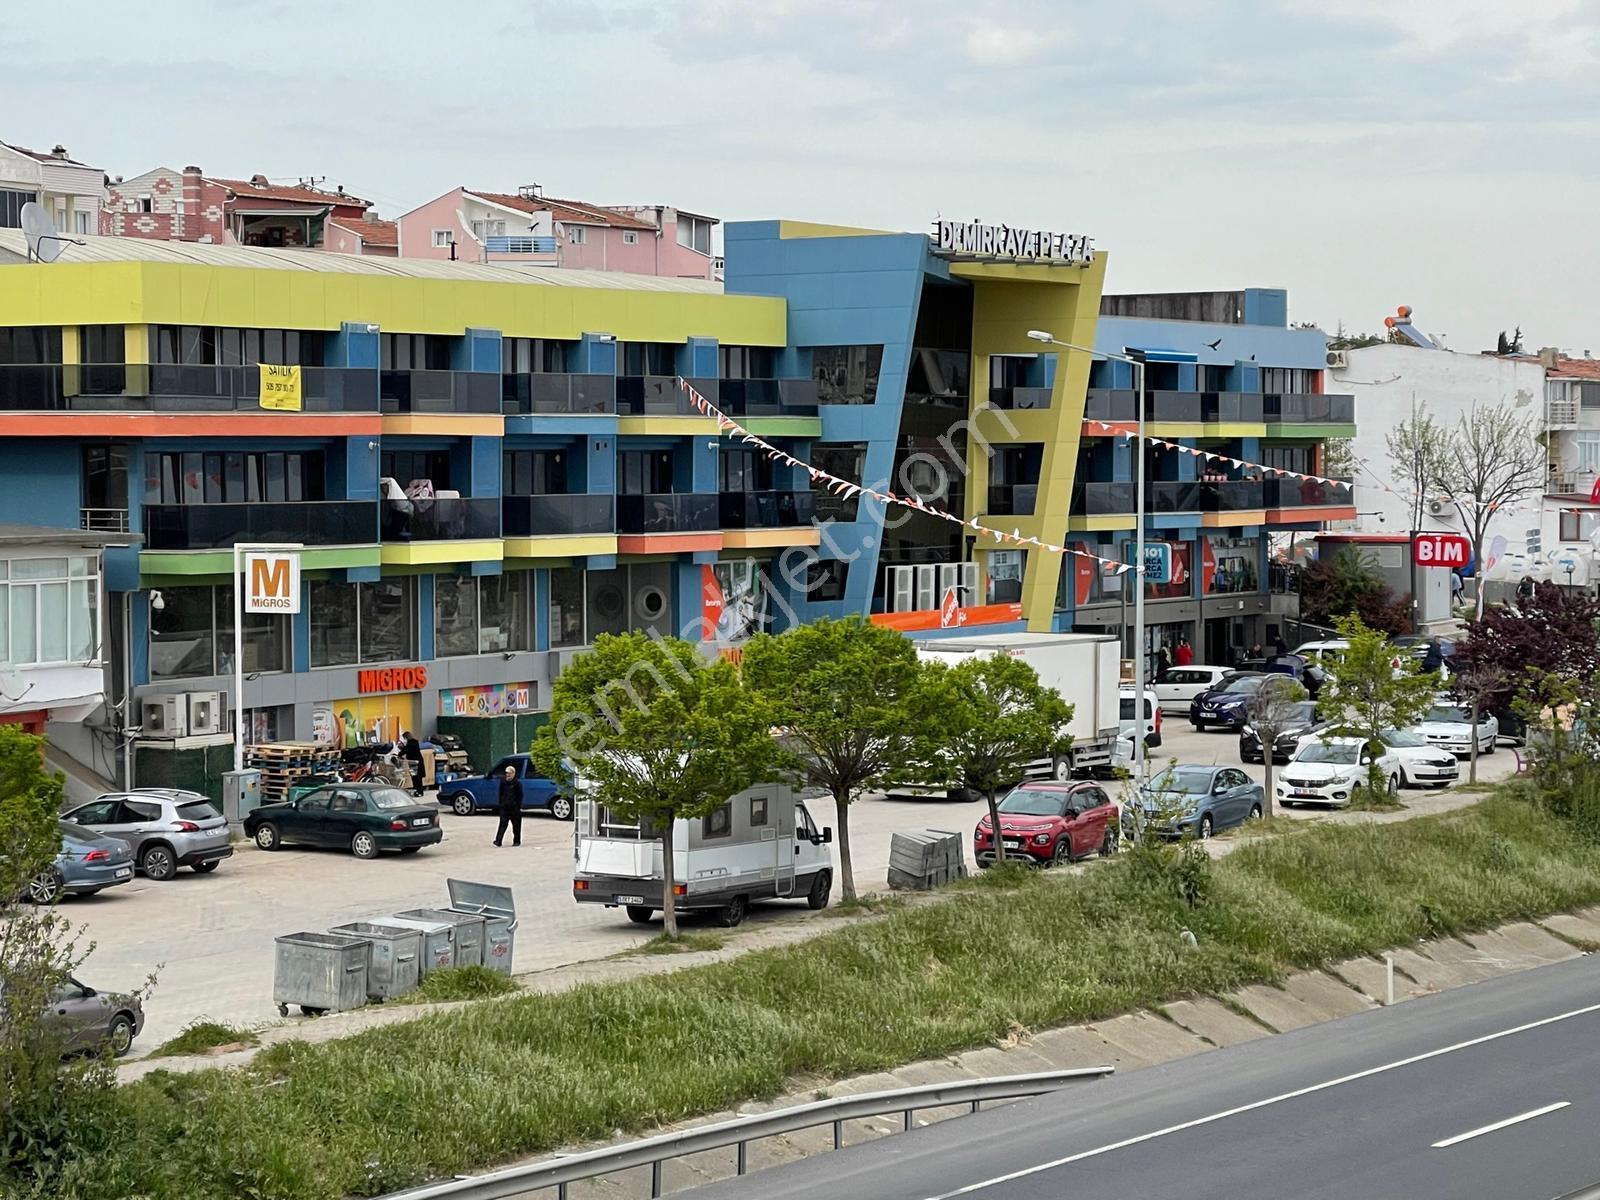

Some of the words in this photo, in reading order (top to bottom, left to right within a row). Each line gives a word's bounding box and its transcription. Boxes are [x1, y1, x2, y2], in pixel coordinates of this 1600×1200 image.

[938, 218, 1037, 258] DEMİRKAYA
[1037, 231, 1094, 262] PLAZA
[268, 366, 292, 377] SATILIK
[1418, 536, 1463, 562] BİM
[252, 559, 290, 597] M
[358, 666, 427, 694] MIGROS
